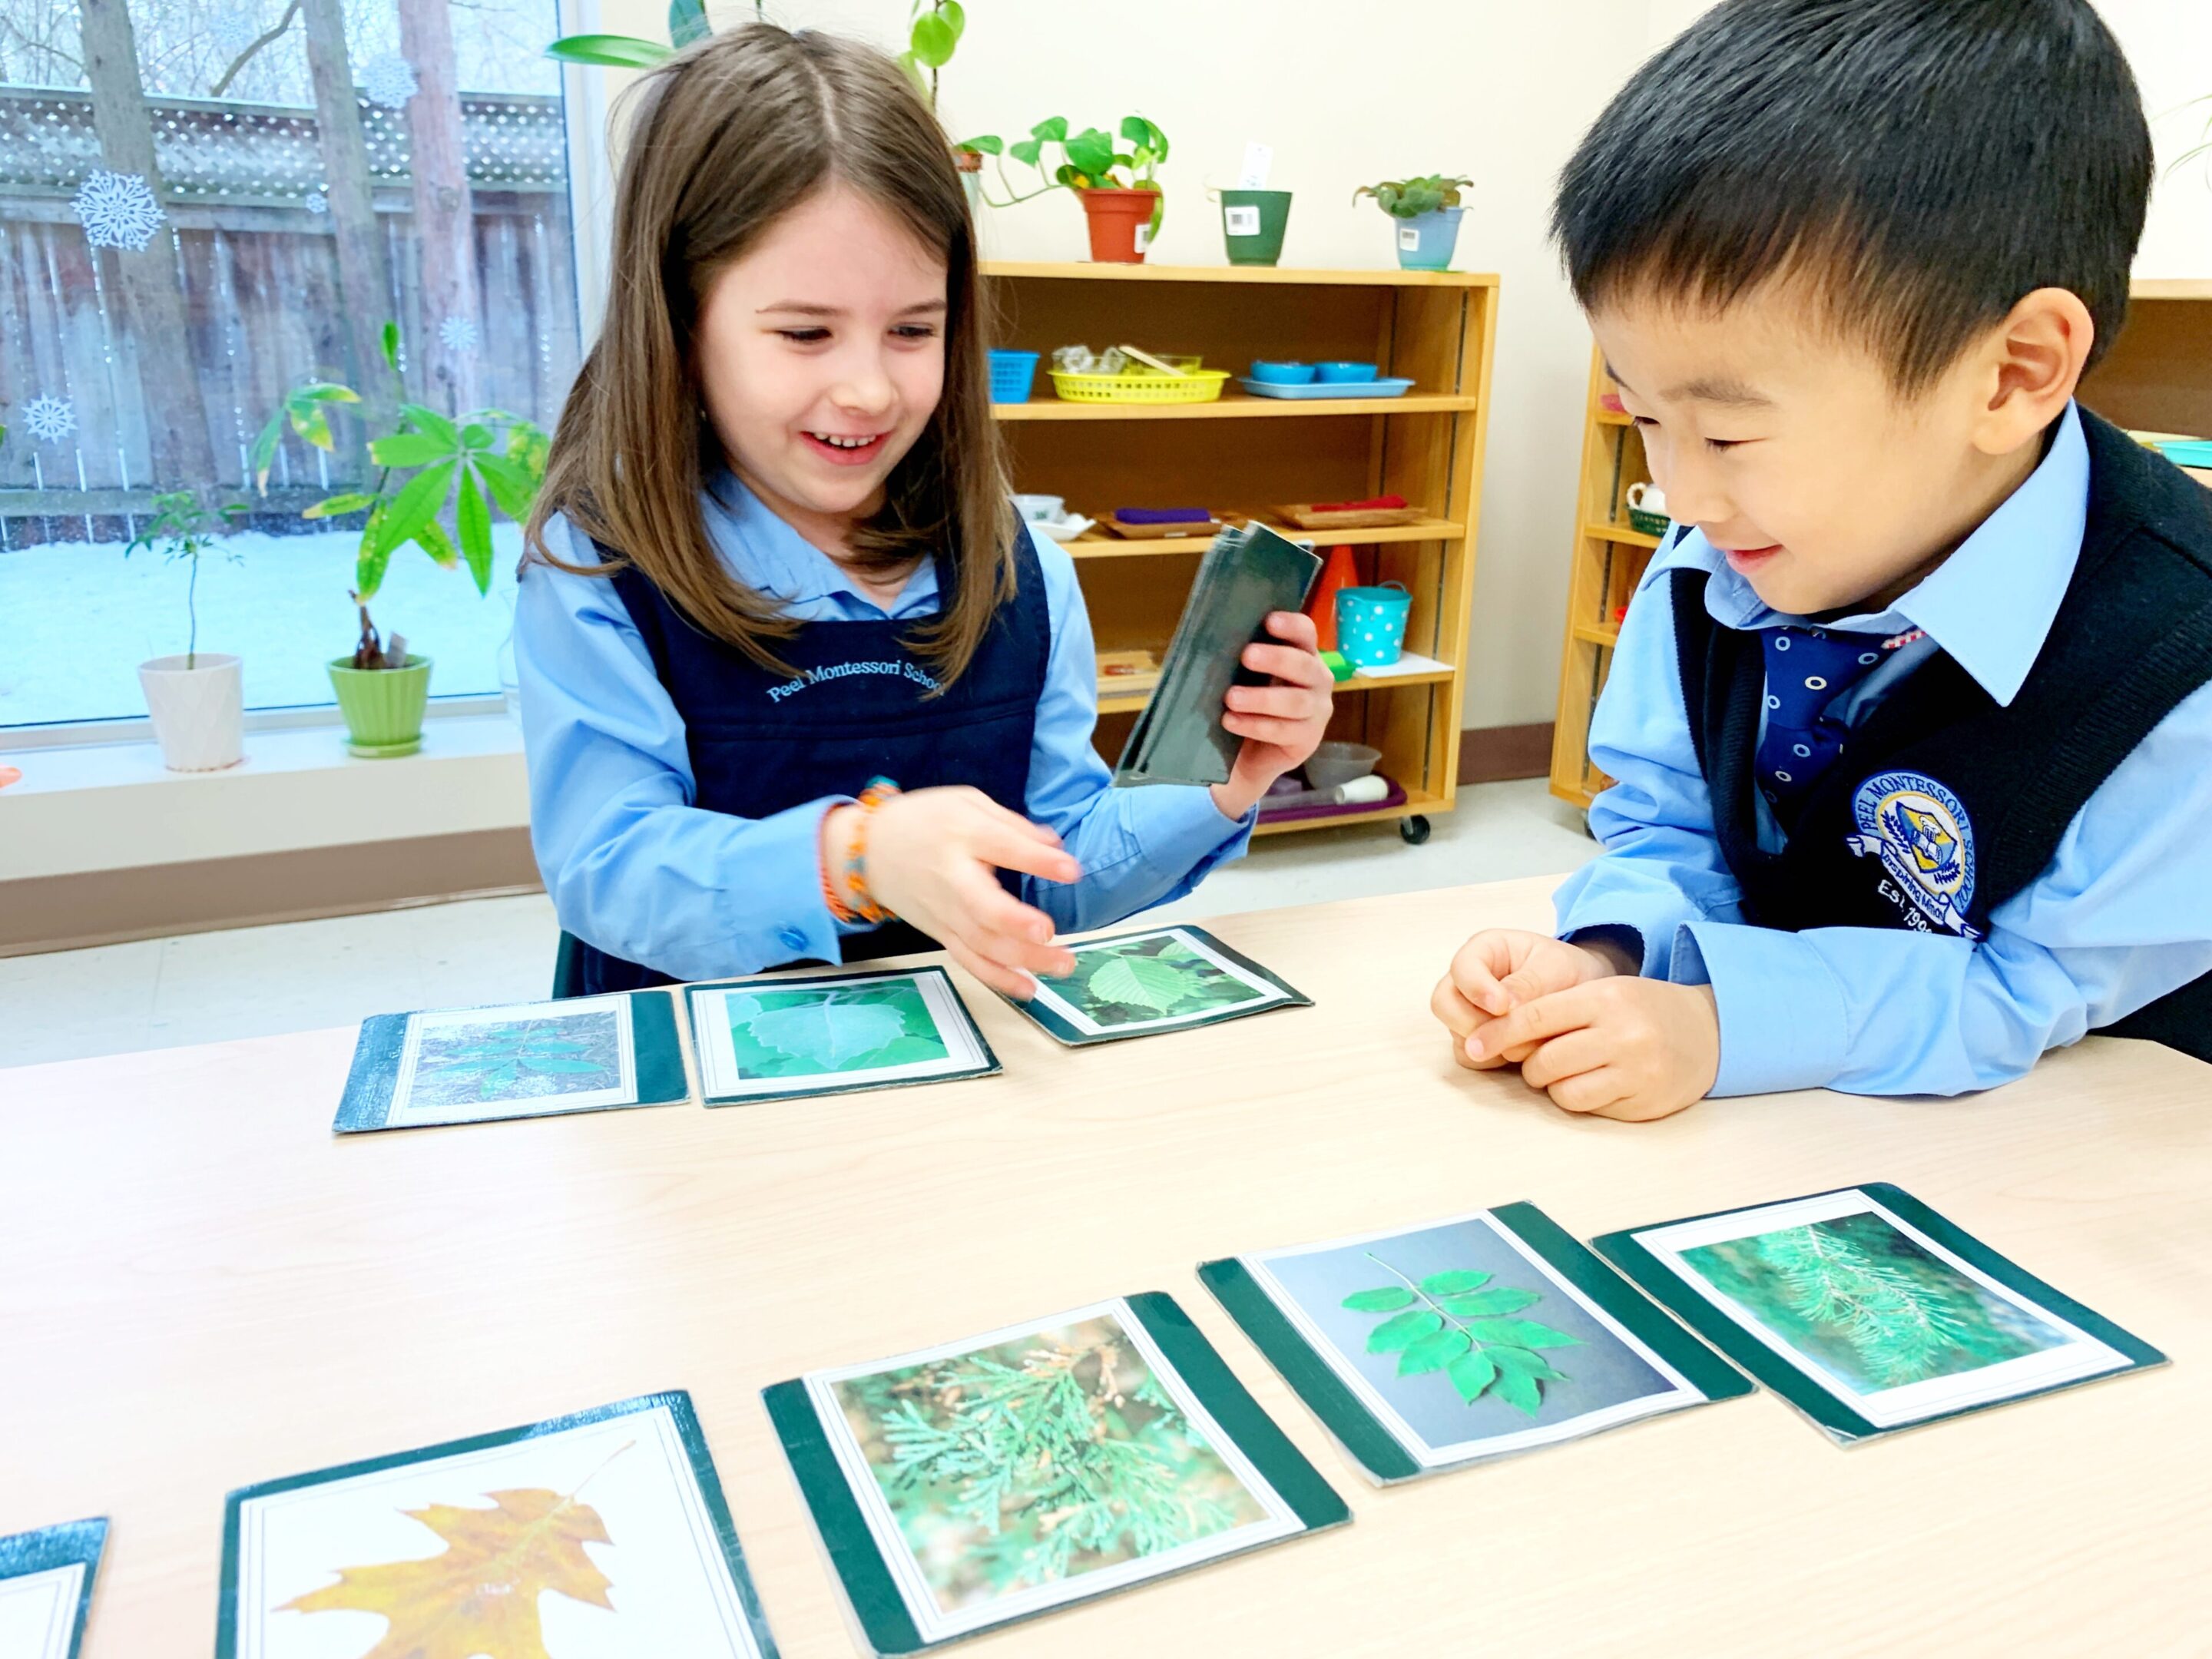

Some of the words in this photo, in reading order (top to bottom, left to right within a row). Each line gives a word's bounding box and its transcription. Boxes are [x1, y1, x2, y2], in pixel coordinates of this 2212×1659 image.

[766, 675, 806, 704] Peel
[806, 659, 902, 685] Montessori
[1859, 799, 1879, 830] PEEL
[1866, 775, 1969, 831] MONTESSORI
[1883, 853, 1922, 902] Inspiring
[1955, 838, 1974, 909] SCHOOL
